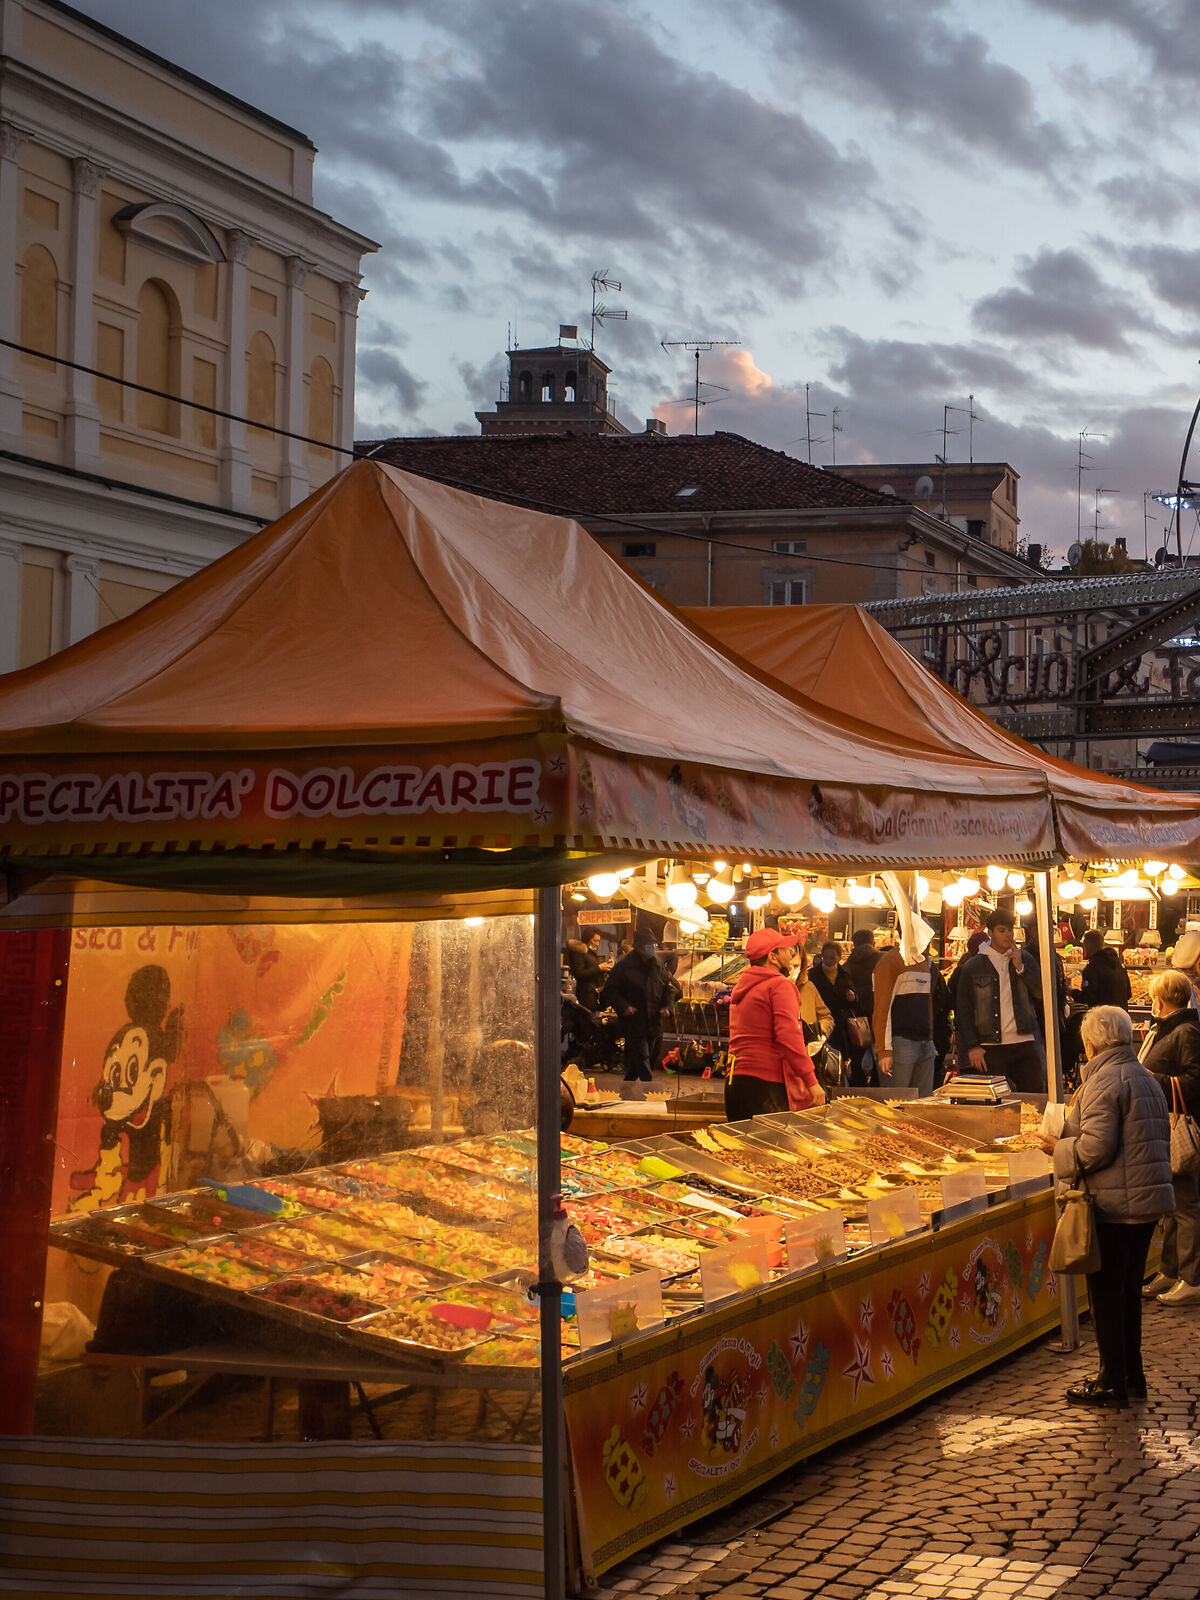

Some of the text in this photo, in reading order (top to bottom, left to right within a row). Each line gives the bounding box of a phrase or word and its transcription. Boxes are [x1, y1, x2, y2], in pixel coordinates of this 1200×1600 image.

[0, 765, 535, 818] PECIALITA' DOLCIARIE
[875, 811, 892, 837] Da
